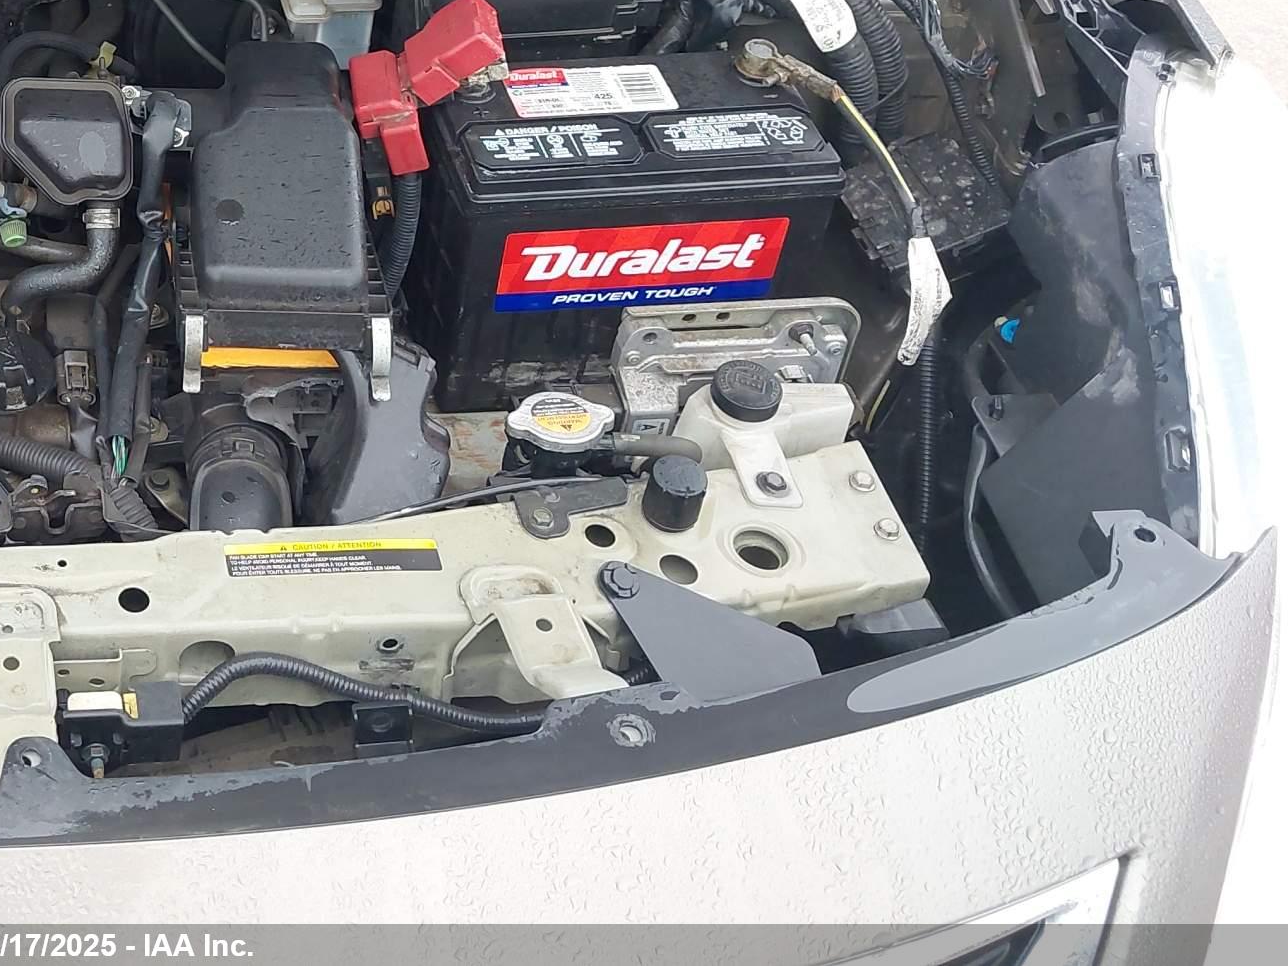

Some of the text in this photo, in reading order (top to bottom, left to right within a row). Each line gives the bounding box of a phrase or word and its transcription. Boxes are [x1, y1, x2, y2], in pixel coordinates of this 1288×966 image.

[509, 70, 557, 81] Duralast
[594, 92, 612, 100] 425
[505, 126, 549, 135] DANGER
[558, 124, 598, 133] POISON
[521, 233, 765, 281] Duralast
[552, 286, 714, 305] PROVEN TOUGH
[292, 543, 329, 551] CAUTION
[337, 541, 382, 549] ATTENTION
